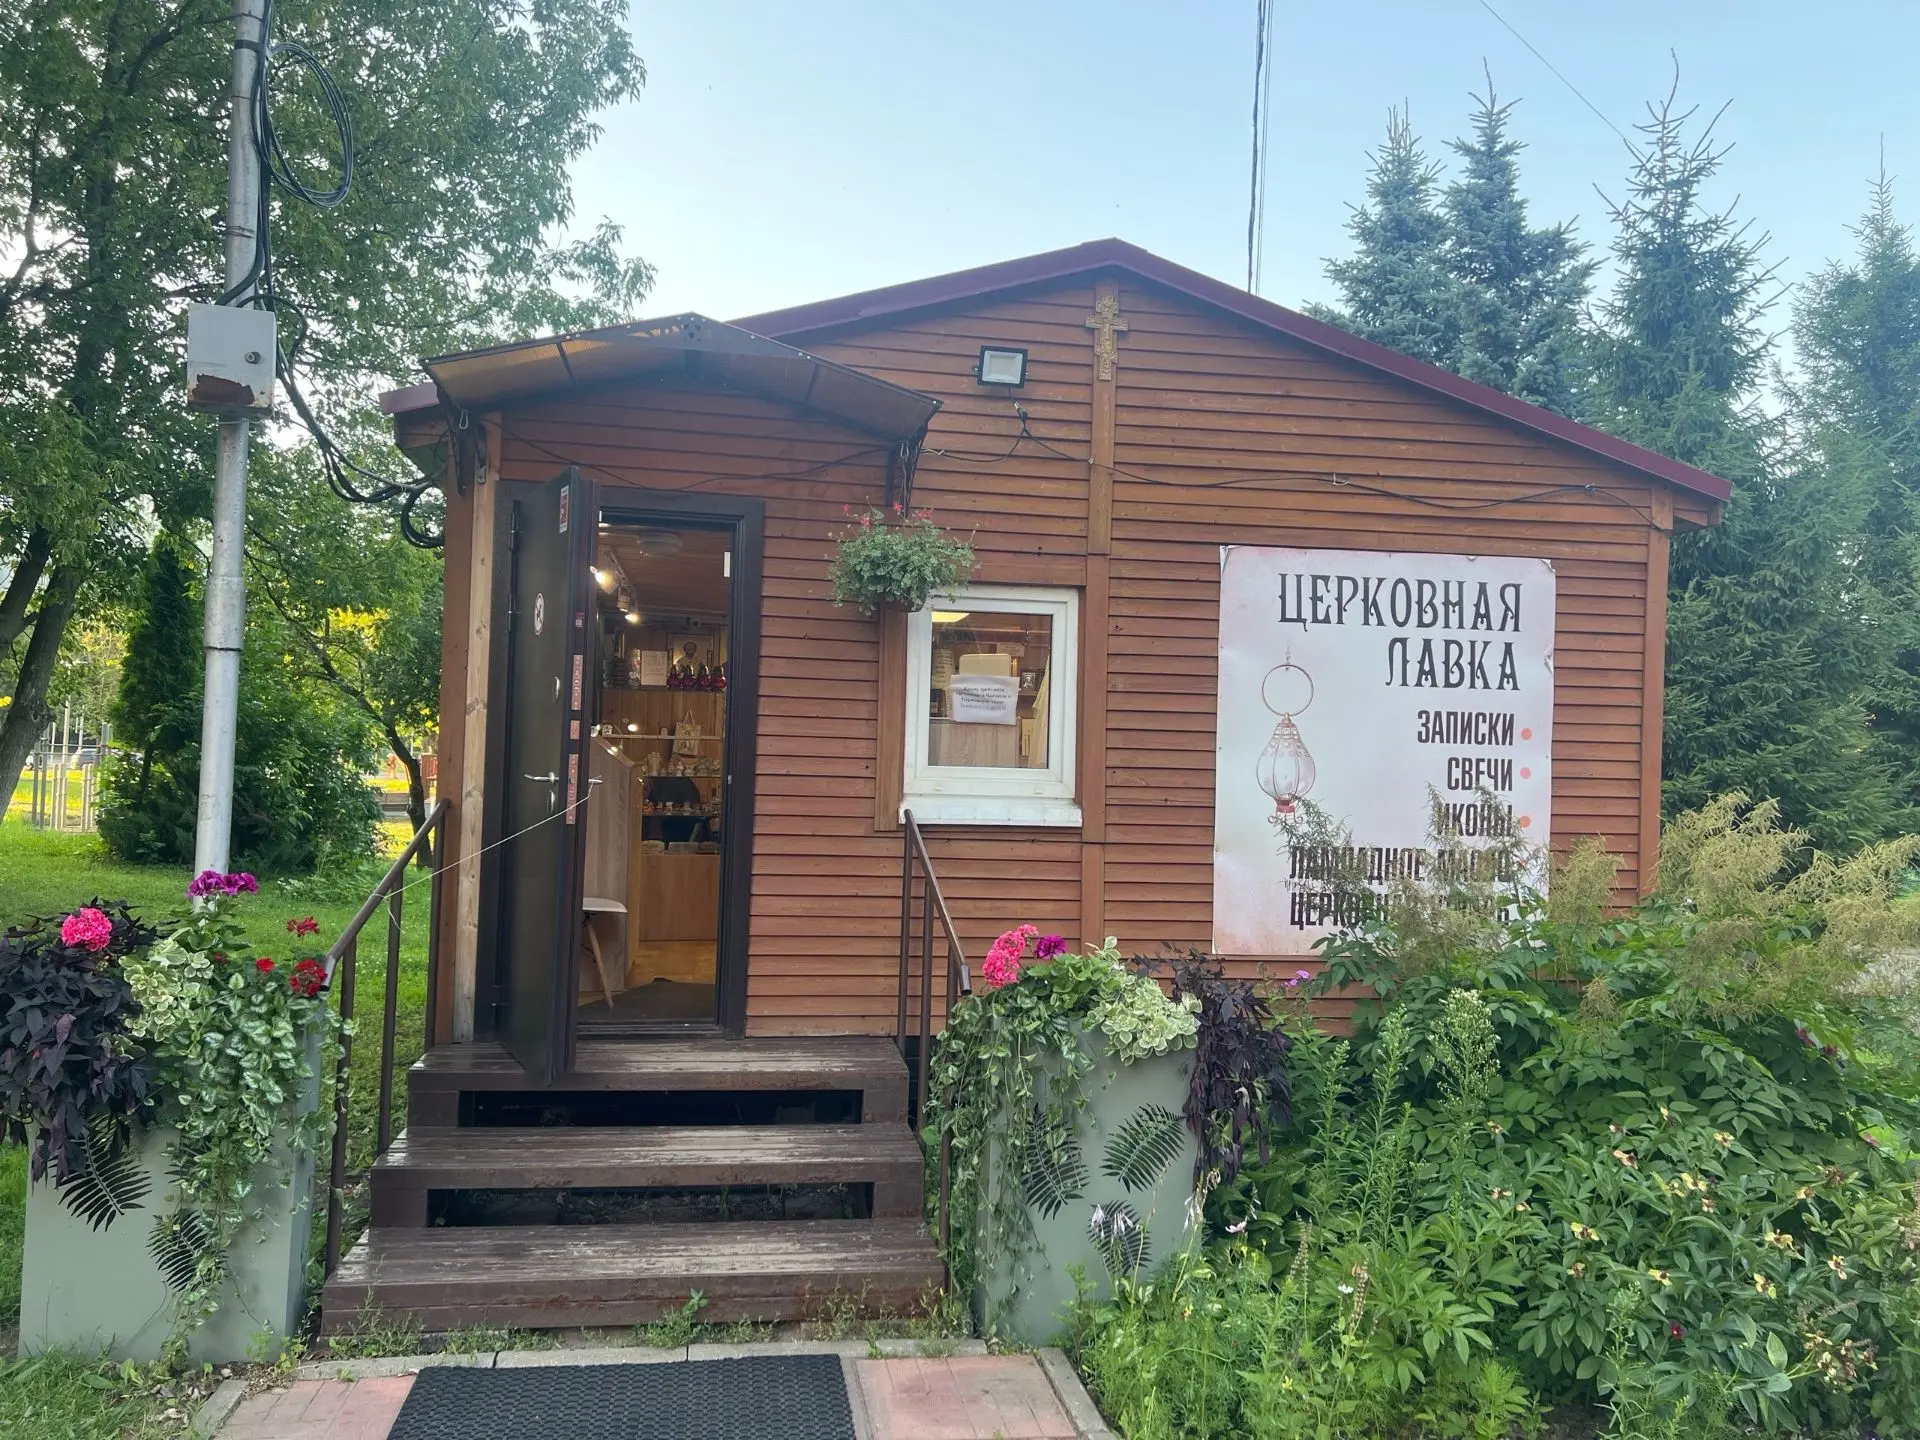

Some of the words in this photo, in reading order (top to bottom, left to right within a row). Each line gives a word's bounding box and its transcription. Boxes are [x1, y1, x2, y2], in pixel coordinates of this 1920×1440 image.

[1278, 573, 1522, 632] ЦЕРКОВНАЯ
[1385, 637, 1520, 691] ЛАВКА
[1417, 709, 1514, 746] ЗАПИСКИ
[1447, 757, 1512, 791] СВЕЧИ
